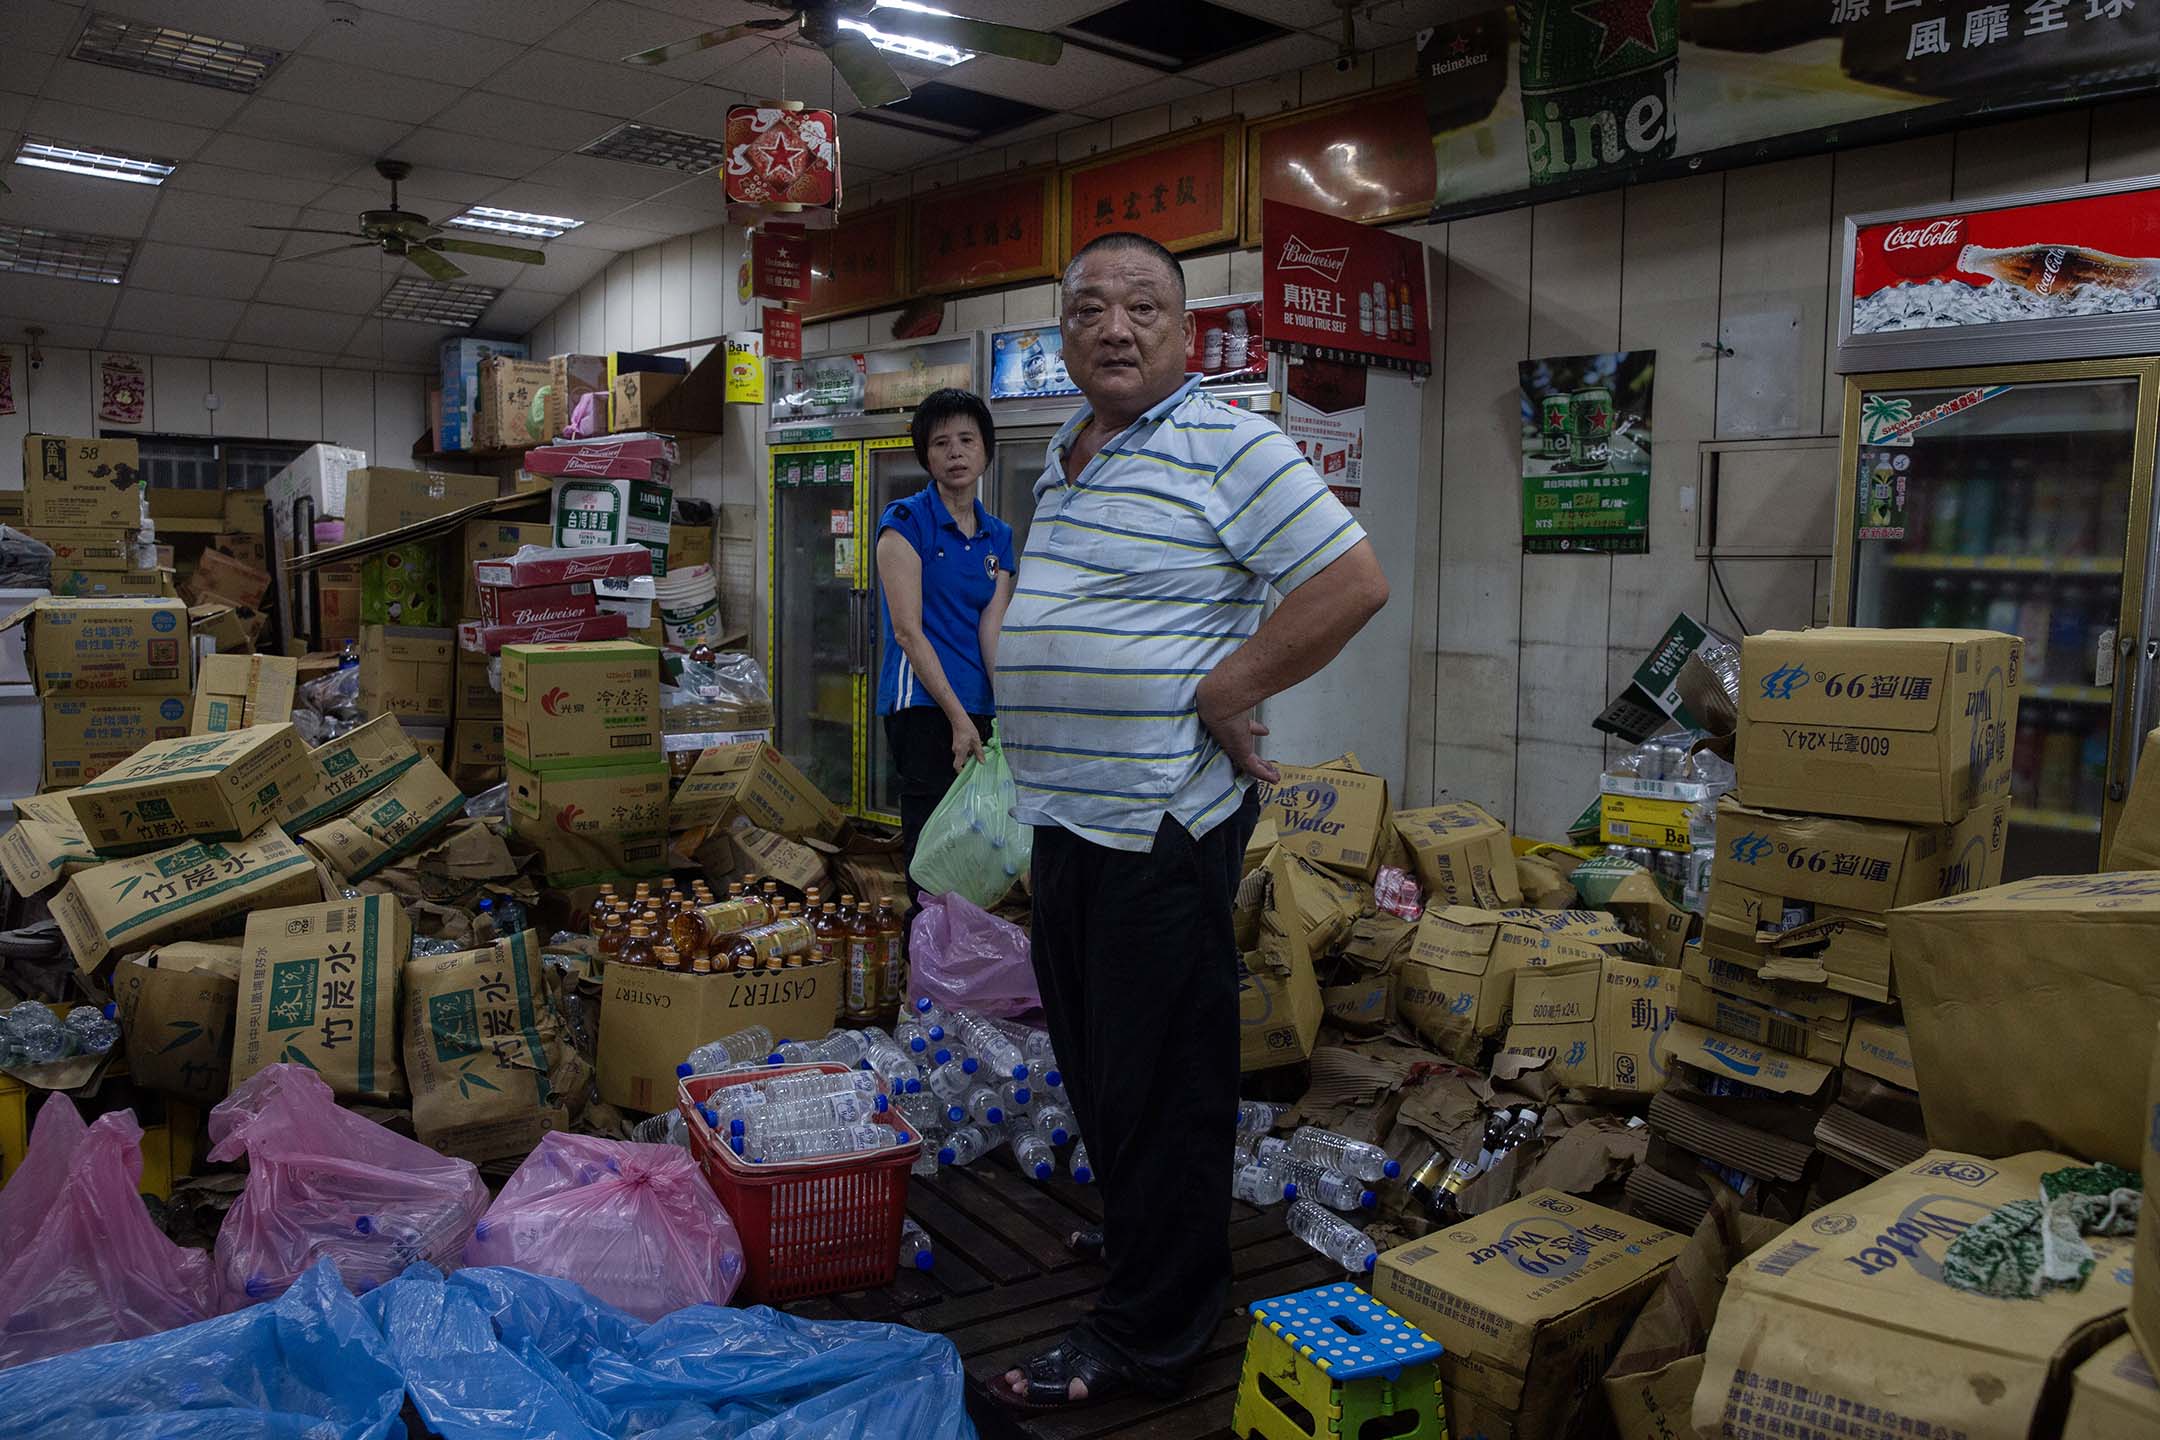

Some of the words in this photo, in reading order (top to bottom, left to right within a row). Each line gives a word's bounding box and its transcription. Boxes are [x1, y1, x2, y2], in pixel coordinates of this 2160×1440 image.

[1431, 52, 1489, 77] Heineken
[1884, 219, 1963, 252] Coca-Cola
[1284, 241, 1344, 271] Budweiser
[2036, 247, 2067, 296] Coca-Cola
[1283, 283, 1347, 318] 真我至上
[1284, 312, 1294, 325] BE
[1295, 314, 1314, 328] YOUR
[1314, 317, 1331, 331] TRUE
[1332, 320, 1347, 334] SELF
[728, 340, 750, 352] Bar
[1882, 418, 1908, 435] SHOW
[80, 447, 98, 460] 58
[569, 458, 608, 471] Budweiser
[568, 562, 609, 575] Budweiser
[512, 607, 585, 626] Budweiser
[534, 628, 579, 642] Budweiser
[1649, 631, 1685, 675] TAIWAN
[1661, 643, 1690, 677] BEER
[597, 688, 648, 706] 冷泡茶
[325, 763, 374, 796] 竹炭水
[137, 820, 189, 840] 竹炭水
[381, 810, 423, 846] 竹炭水
[1284, 809, 1345, 836] Water
[143, 852, 256, 903] 竹炭水
[321, 941, 357, 1049] 竹炭水
[479, 971, 522, 1069] 竹炭水
[1616, 1075, 1636, 1084] TQF
[1466, 1229, 1552, 1265] Water
